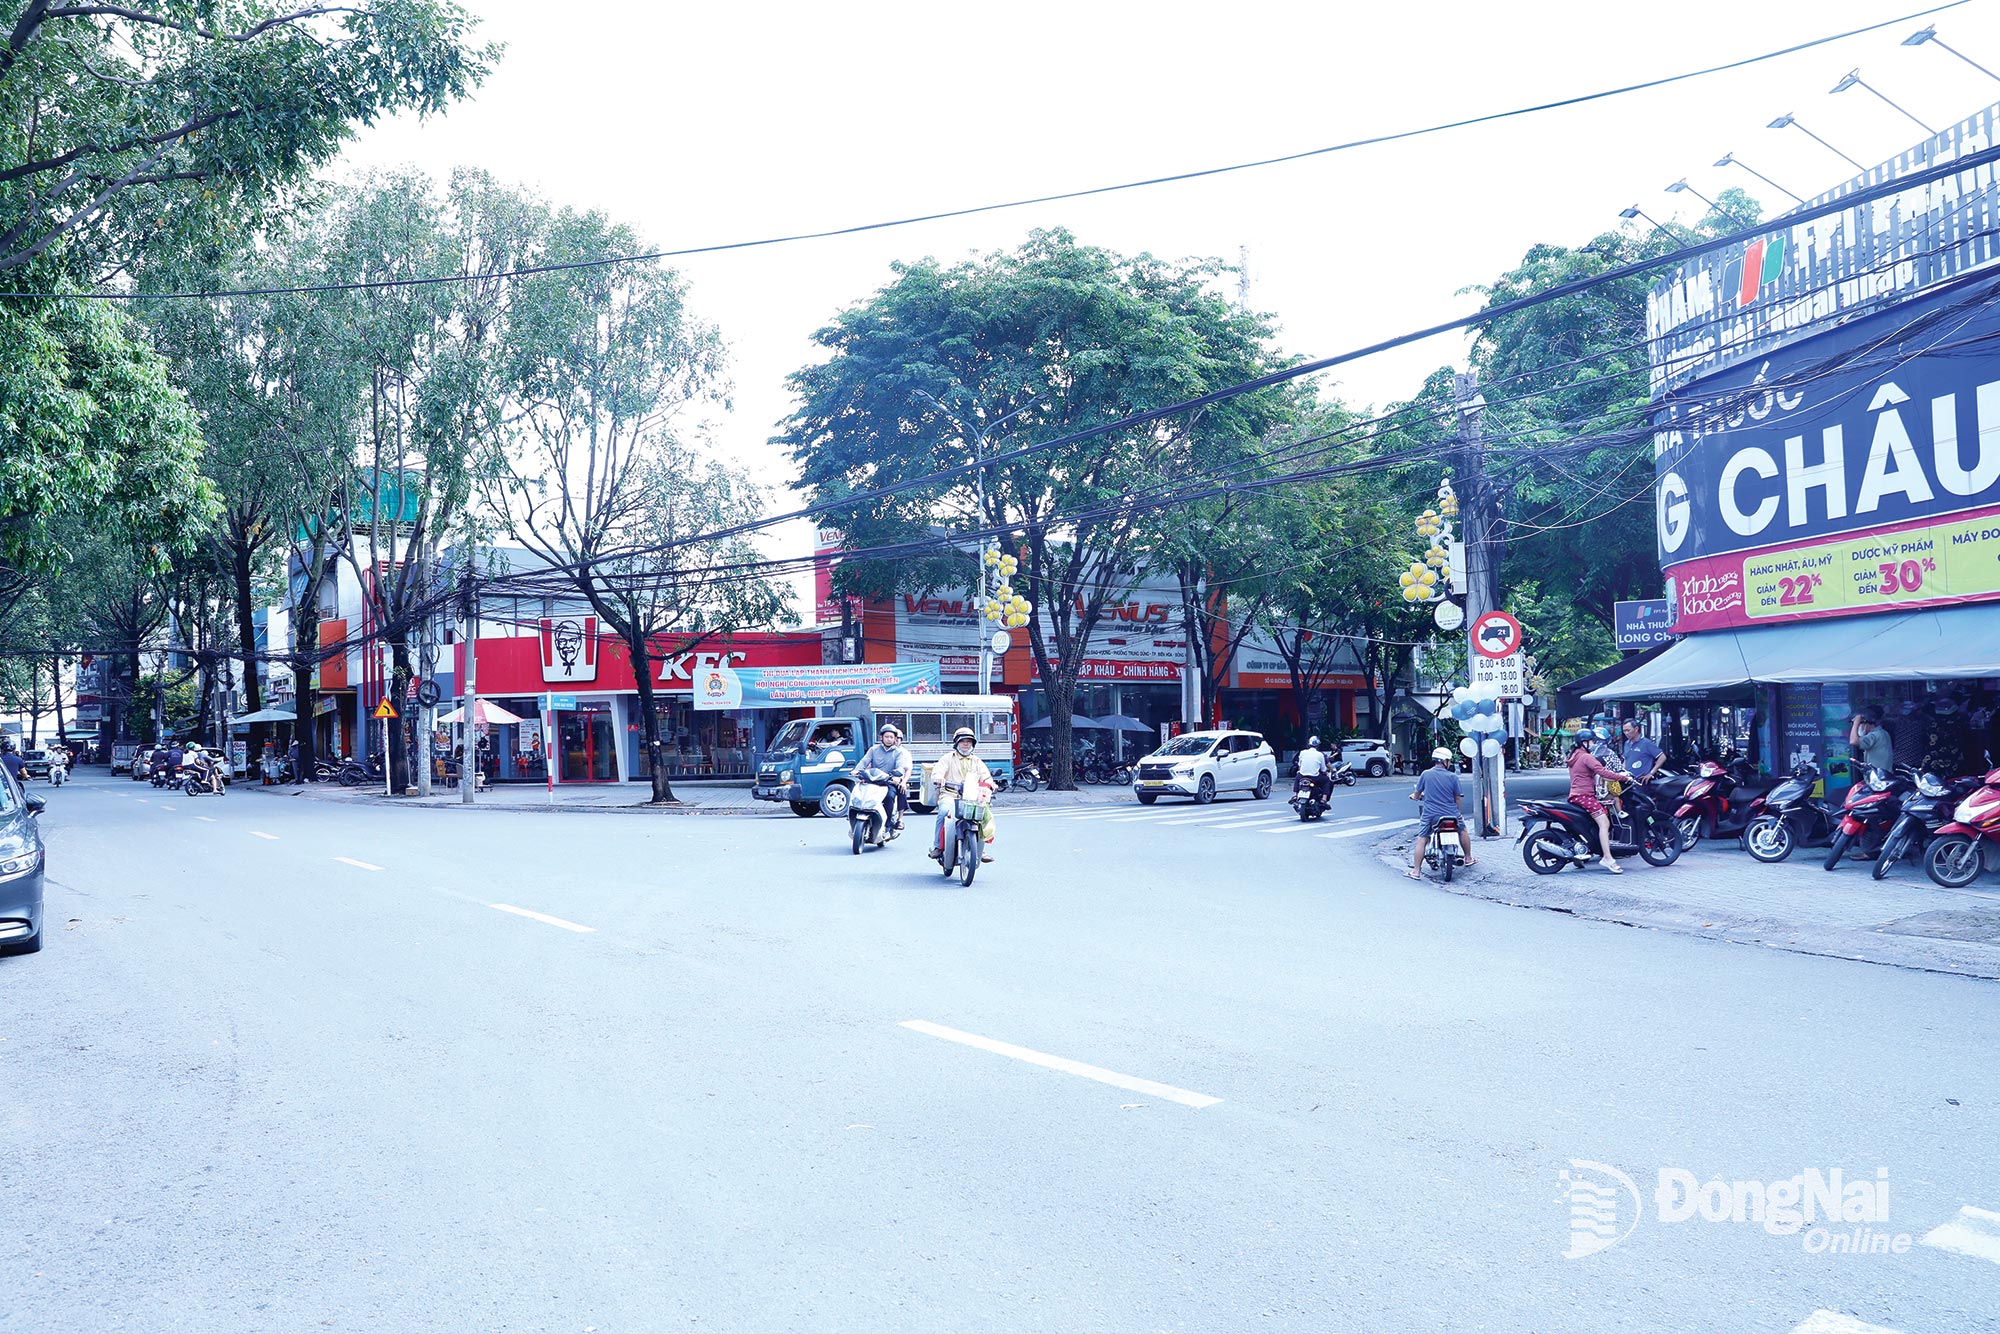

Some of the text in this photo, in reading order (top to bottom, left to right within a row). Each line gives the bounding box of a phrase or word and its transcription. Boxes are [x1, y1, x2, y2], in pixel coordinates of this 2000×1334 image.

[1718, 380, 2000, 536] CHÂU
[1952, 530, 1979, 545] MÁY
[1851, 537, 1934, 561] DƯỢC MỸ PHẨM
[1749, 566, 1775, 577] HÀNG
[1775, 559, 1801, 573] NHẬT,
[1818, 553, 1833, 566] MỸ
[1853, 569, 1878, 582] GIẢM
[1878, 556, 1937, 596] 30%
[1756, 582, 1777, 595] GIẢM
[1777, 573, 1823, 607] 22%
[1858, 582, 1878, 595] ĐẾN
[904, 594, 979, 617] VENU
[1760, 596, 1777, 607] ĐẾN
[1626, 620, 1646, 631] NHÀ
[1618, 632, 1651, 643] LONG
[1094, 660, 1115, 677] KHẨU
[1123, 662, 1148, 677] CHÍNH
